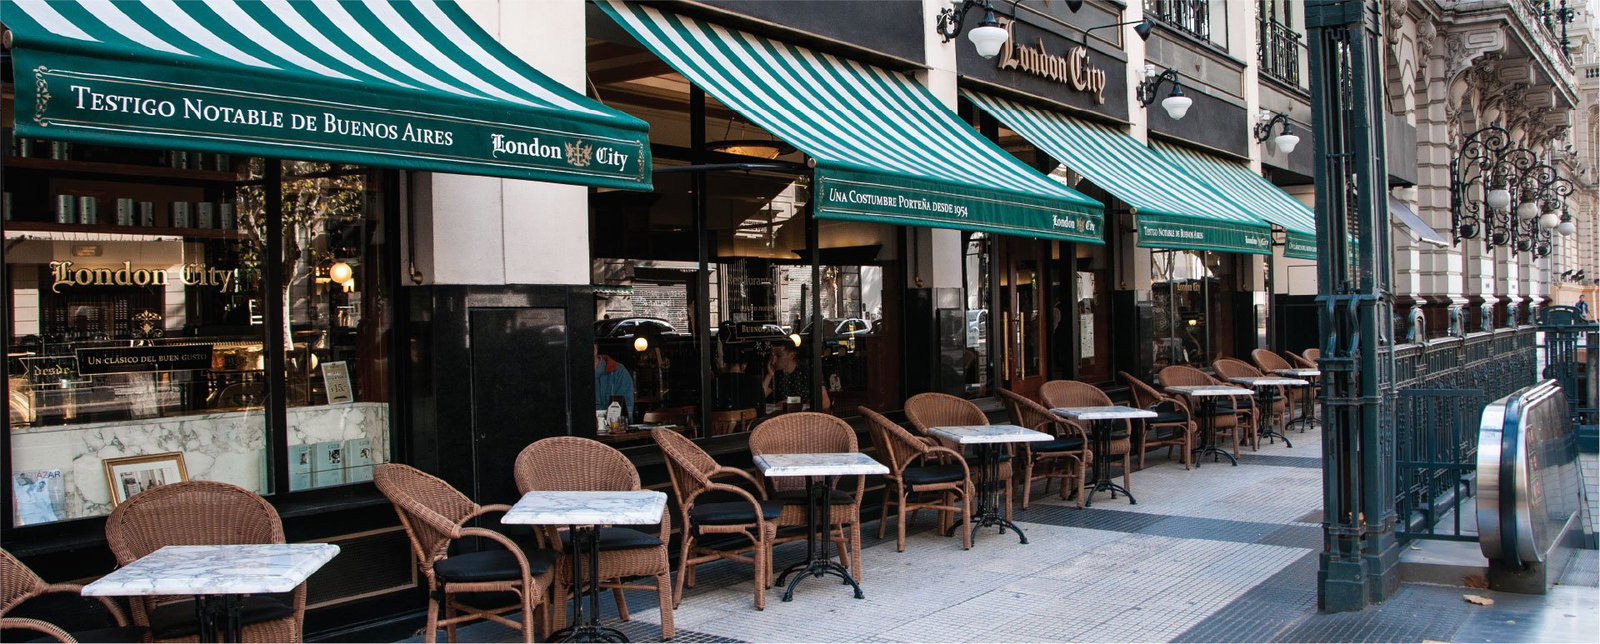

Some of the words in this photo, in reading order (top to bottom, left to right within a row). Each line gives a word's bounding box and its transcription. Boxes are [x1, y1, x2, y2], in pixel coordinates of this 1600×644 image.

[998, 17, 1067, 84] London
[1068, 45, 1106, 105] City
[70, 85, 175, 118] TESTIGO
[182, 98, 284, 128] NOTABLE
[291, 113, 317, 132] DE
[323, 112, 398, 140] BUENOS
[401, 122, 453, 146] AIRES
[490, 133, 562, 160] London
[595, 147, 629, 172] City
[829, 187, 848, 202] UNA
[848, 190, 897, 207] COSTUMBRE
[898, 195, 931, 211] PORTEÑA
[932, 201, 953, 214] DESDE
[953, 205, 969, 218] 1954
[1052, 214, 1075, 229] London
[50, 260, 168, 294] London
[179, 262, 231, 294] City
[33, 364, 71, 377] desde
[87, 356, 102, 365] UN
[104, 355, 138, 365] CLÁSICO
[140, 355, 157, 363] DEL
[158, 354, 179, 363] BUEN
[181, 352, 207, 361] GUSTO
